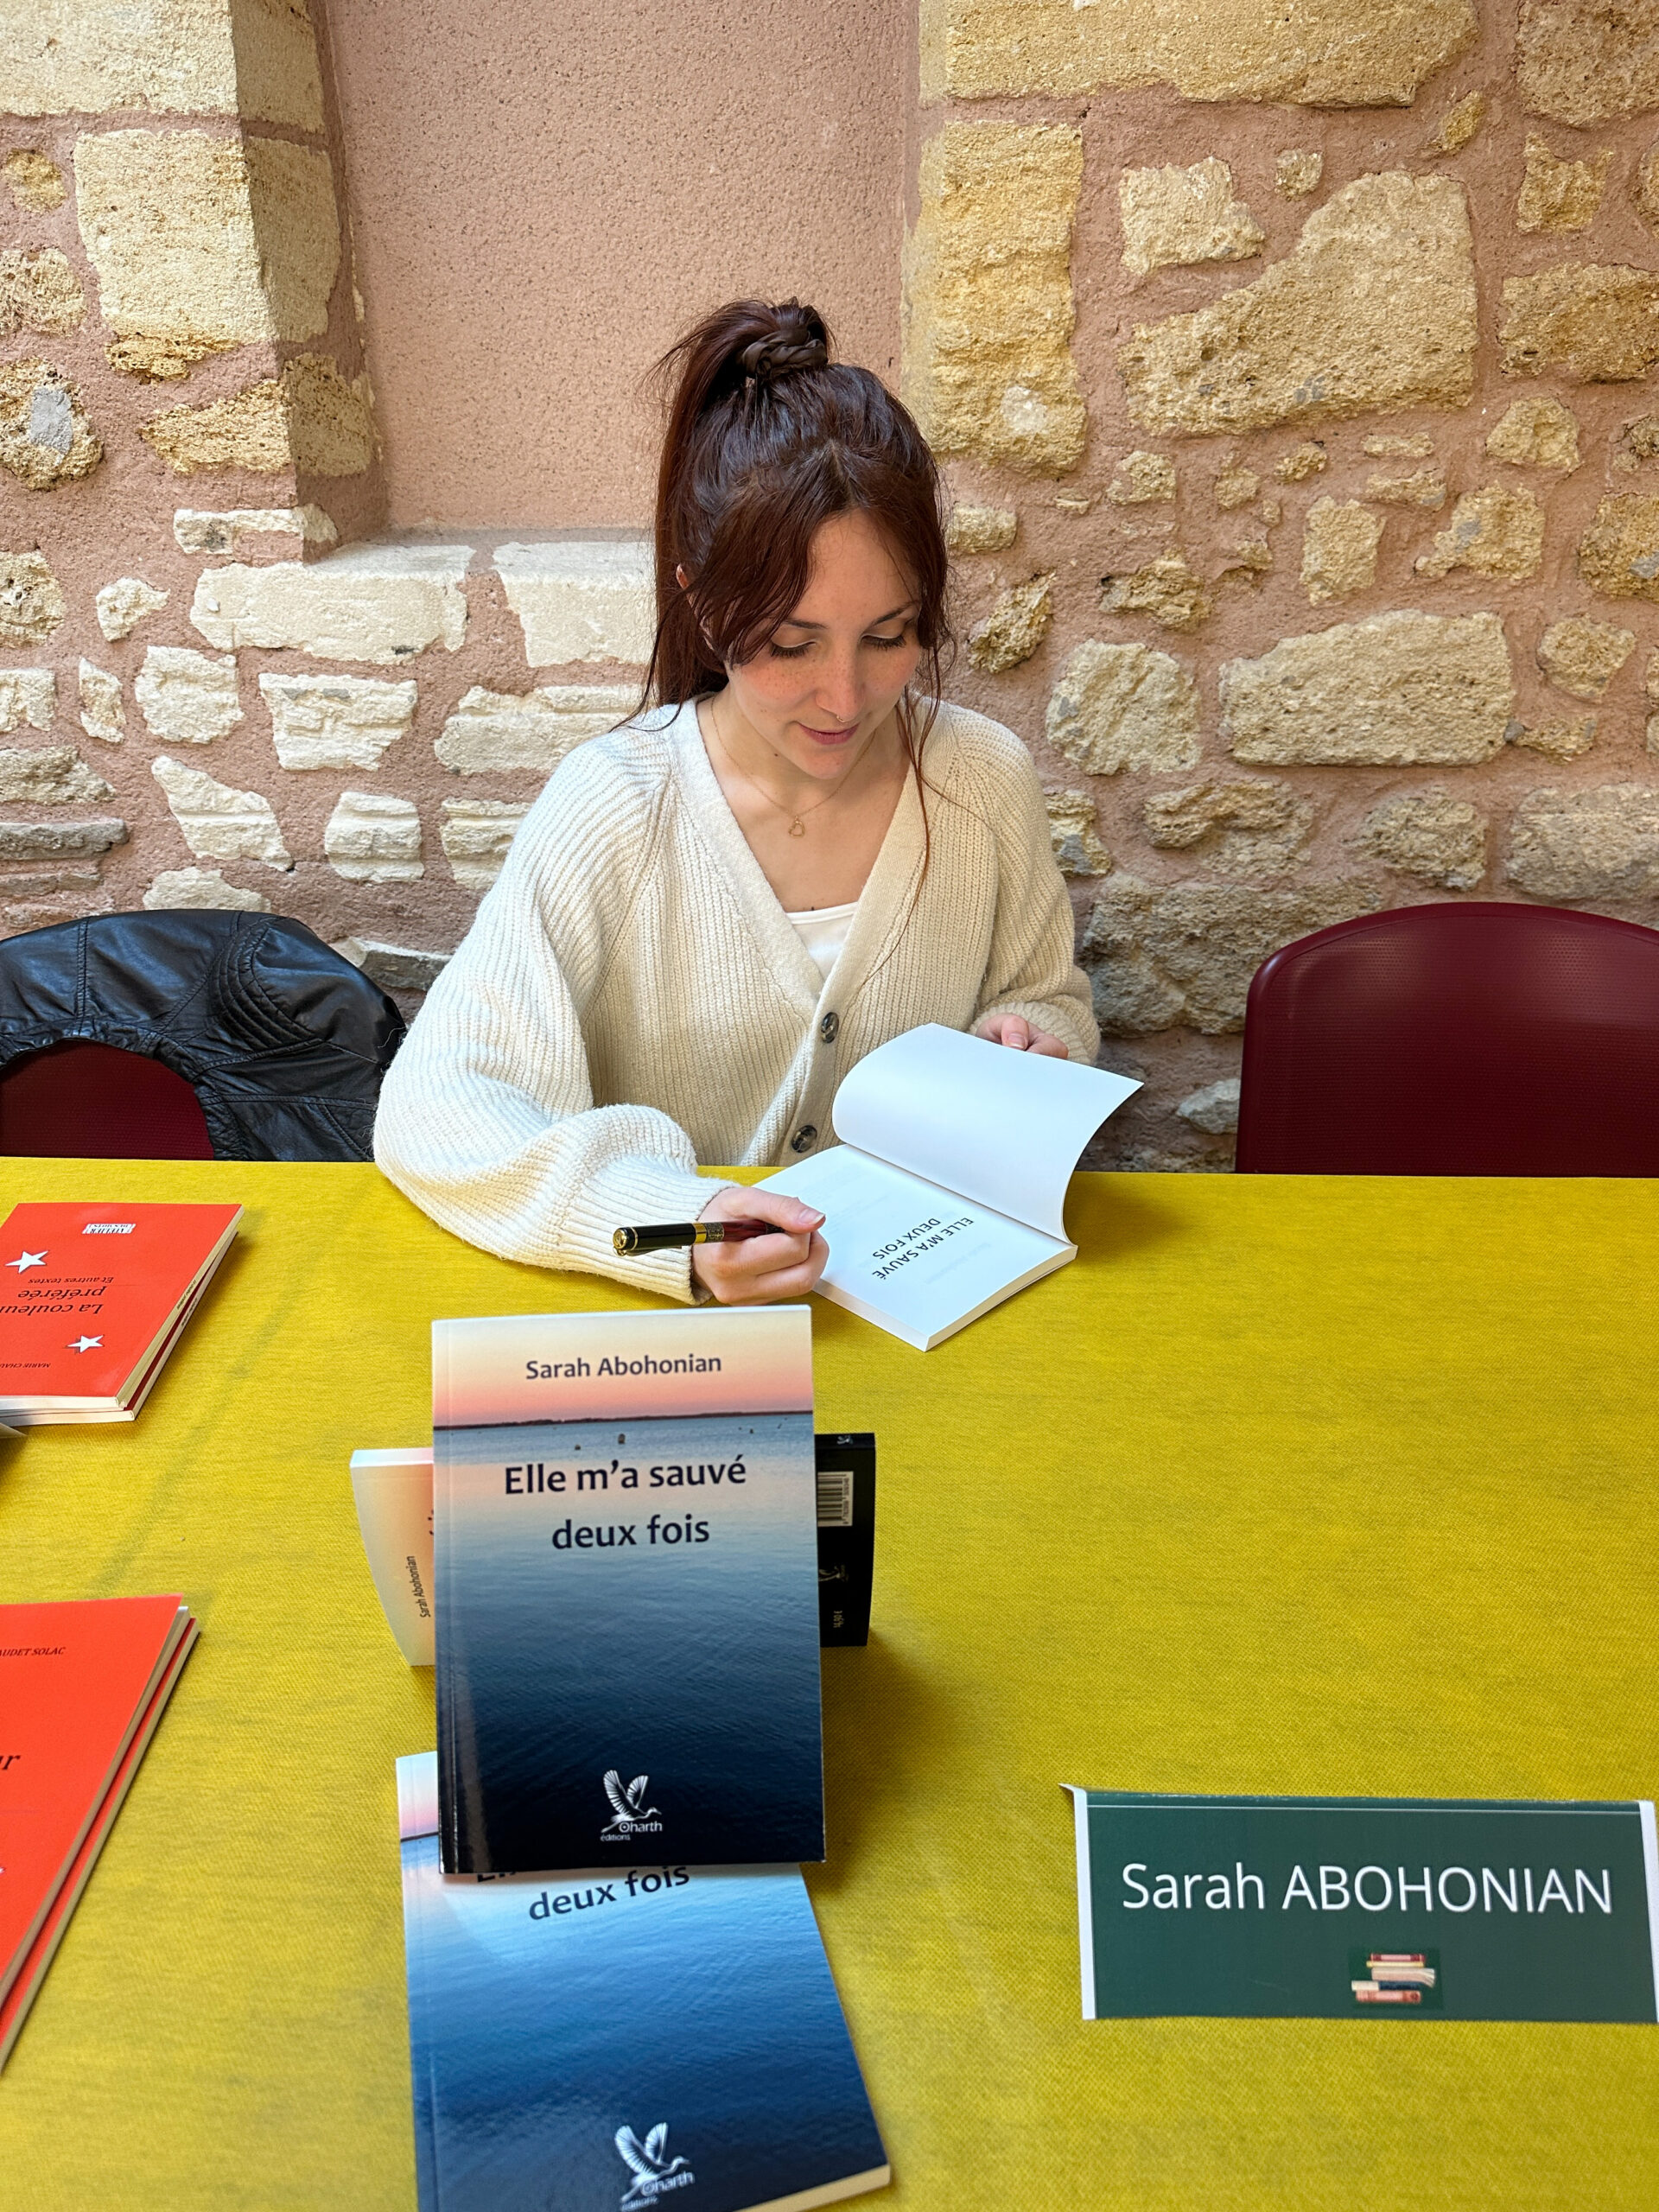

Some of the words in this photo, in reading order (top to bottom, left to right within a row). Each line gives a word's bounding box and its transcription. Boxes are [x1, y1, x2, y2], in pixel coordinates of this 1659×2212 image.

[902, 1217, 941, 1241] DEUX
[940, 1217, 975, 1236] ELLE
[872, 1238, 906, 1259] FOIS
[915, 1234, 944, 1251] M'A
[872, 1249, 919, 1280] SAUVÉ
[17, 1286, 107, 1300] préférée
[79, 1303, 104, 1314] La
[525, 1357, 591, 1380] Sarah
[597, 1353, 722, 1376] Abohonian
[505, 1463, 567, 1495] Elle
[576, 1459, 639, 1491] m'a
[649, 1454, 747, 1487] sauvé
[551, 1518, 638, 1550] deux
[646, 1513, 710, 1545] fois
[405, 1555, 425, 1598] Abohonian
[416, 1598, 431, 1618] Sarah
[32, 1647, 67, 1656] SOLAC
[528, 1883, 618, 1921] deux
[624, 1866, 691, 1897] fois
[1122, 1861, 1265, 1910] Sarah
[1281, 1864, 1613, 1914] ABOHONIAN
